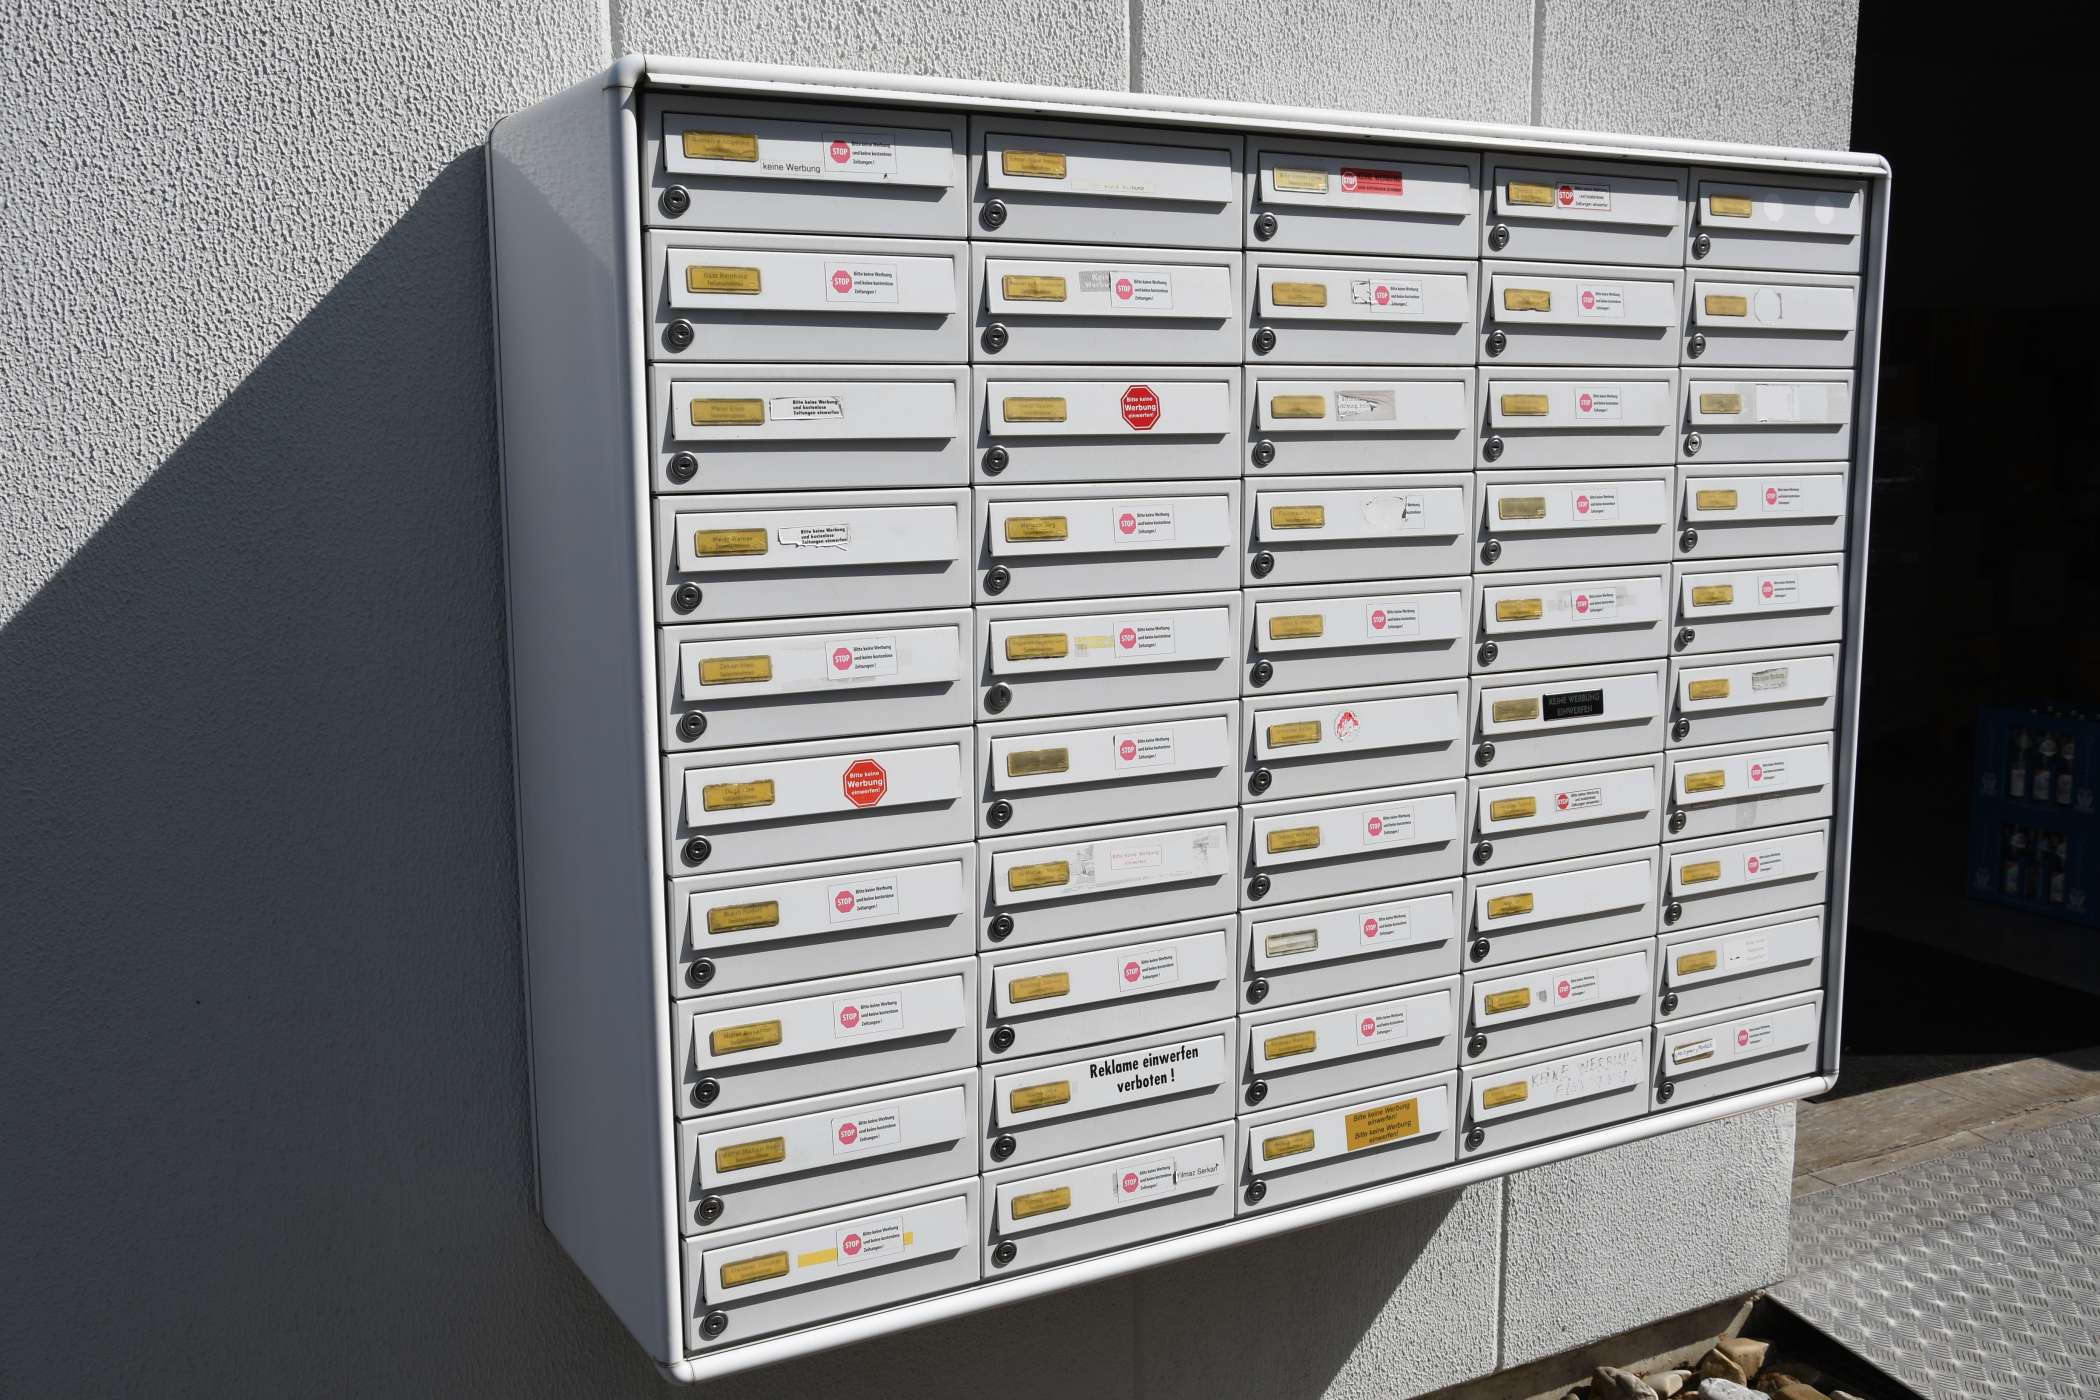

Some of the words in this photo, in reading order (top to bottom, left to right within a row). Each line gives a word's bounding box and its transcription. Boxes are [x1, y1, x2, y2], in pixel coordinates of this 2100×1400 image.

[762, 162, 783, 171] keine
[786, 162, 820, 174] Werbung
[835, 655, 850, 663] STOP
[848, 779, 882, 787] Werbung
[838, 897, 852, 906] STOP
[1126, 968, 1139, 976] STOP
[843, 1013, 857, 1021] STOP
[1090, 1059, 1139, 1078] Reklame
[1142, 1045, 1198, 1068] einwerfen
[1117, 1074, 1167, 1092] verboten
[1384, 1103, 1410, 1114] Werbung
[1368, 1113, 1398, 1126] einwerfen!
[841, 1129, 855, 1138] STOP
[1354, 1132, 1368, 1140] Bitte
[1386, 1120, 1412, 1131] Werbung
[1369, 1131, 1399, 1143] einwerfen!
[845, 1240, 860, 1249] STOP
